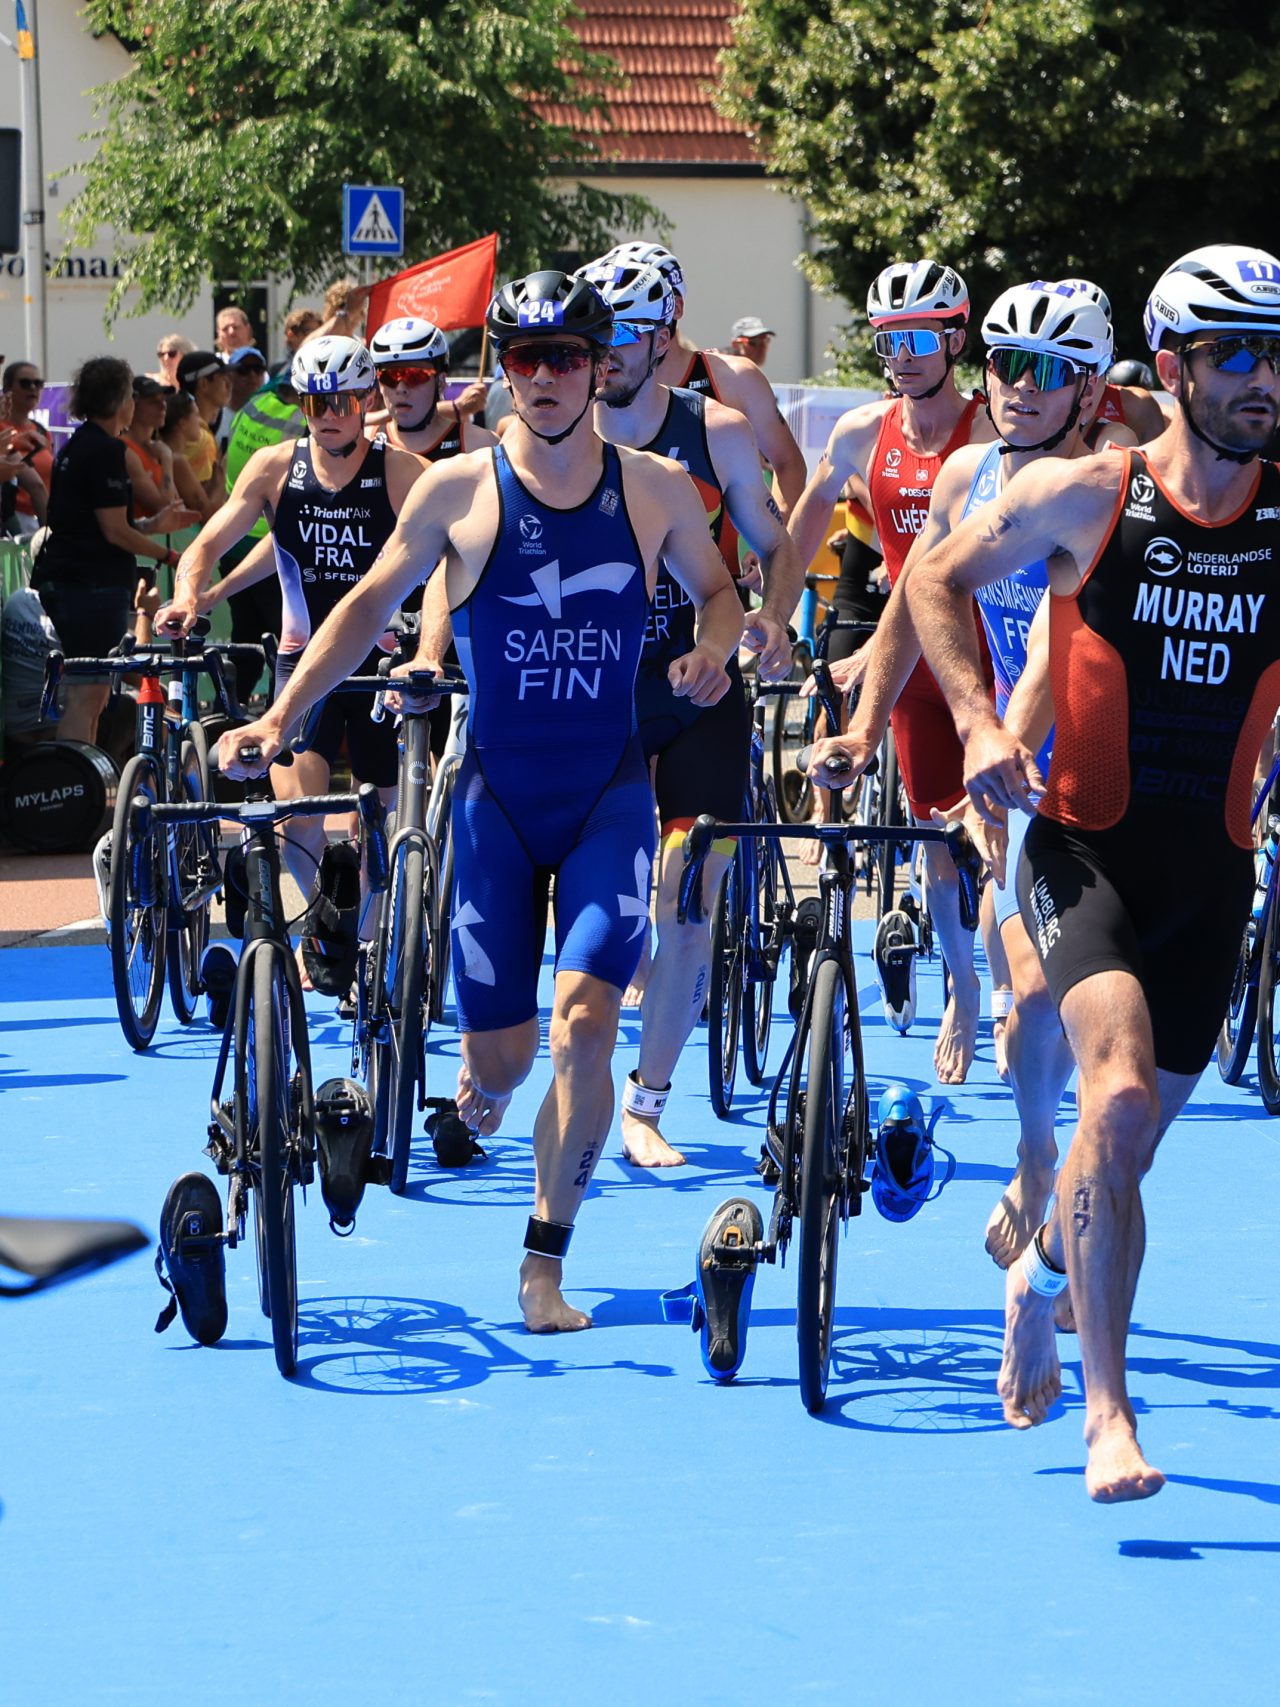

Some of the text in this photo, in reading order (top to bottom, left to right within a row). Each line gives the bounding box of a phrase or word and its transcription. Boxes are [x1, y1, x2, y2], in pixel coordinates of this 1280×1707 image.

[670, 269, 682, 285] 42
[1246, 260, 1275, 280] 17
[527, 301, 556, 324] 24
[1154, 298, 1176, 323] ABUS
[312, 372, 332, 391] 18
[312, 505, 371, 519] Triathl'Aix
[1124, 508, 1156, 523] Triathlon
[1130, 502, 1152, 514] World
[298, 520, 372, 547] VIDAL
[522, 541, 542, 549] World
[314, 546, 355, 568] FRA
[518, 547, 547, 555] Triathlon
[1187, 548, 1272, 564] NEDERLANDSE
[1187, 562, 1239, 576] LOTERIJ
[1132, 582, 1266, 633] MURRAY
[504, 621, 621, 663] SARÉN
[1160, 636, 1231, 685] NED
[517, 667, 602, 700] FIN
[142, 705, 155, 749] BMC
[15, 785, 84, 809] MYLAPS
[1029, 887, 1049, 959] TRIATHLON
[1034, 876, 1061, 948] LIMBURG
[573, 1149, 594, 1189] 24
